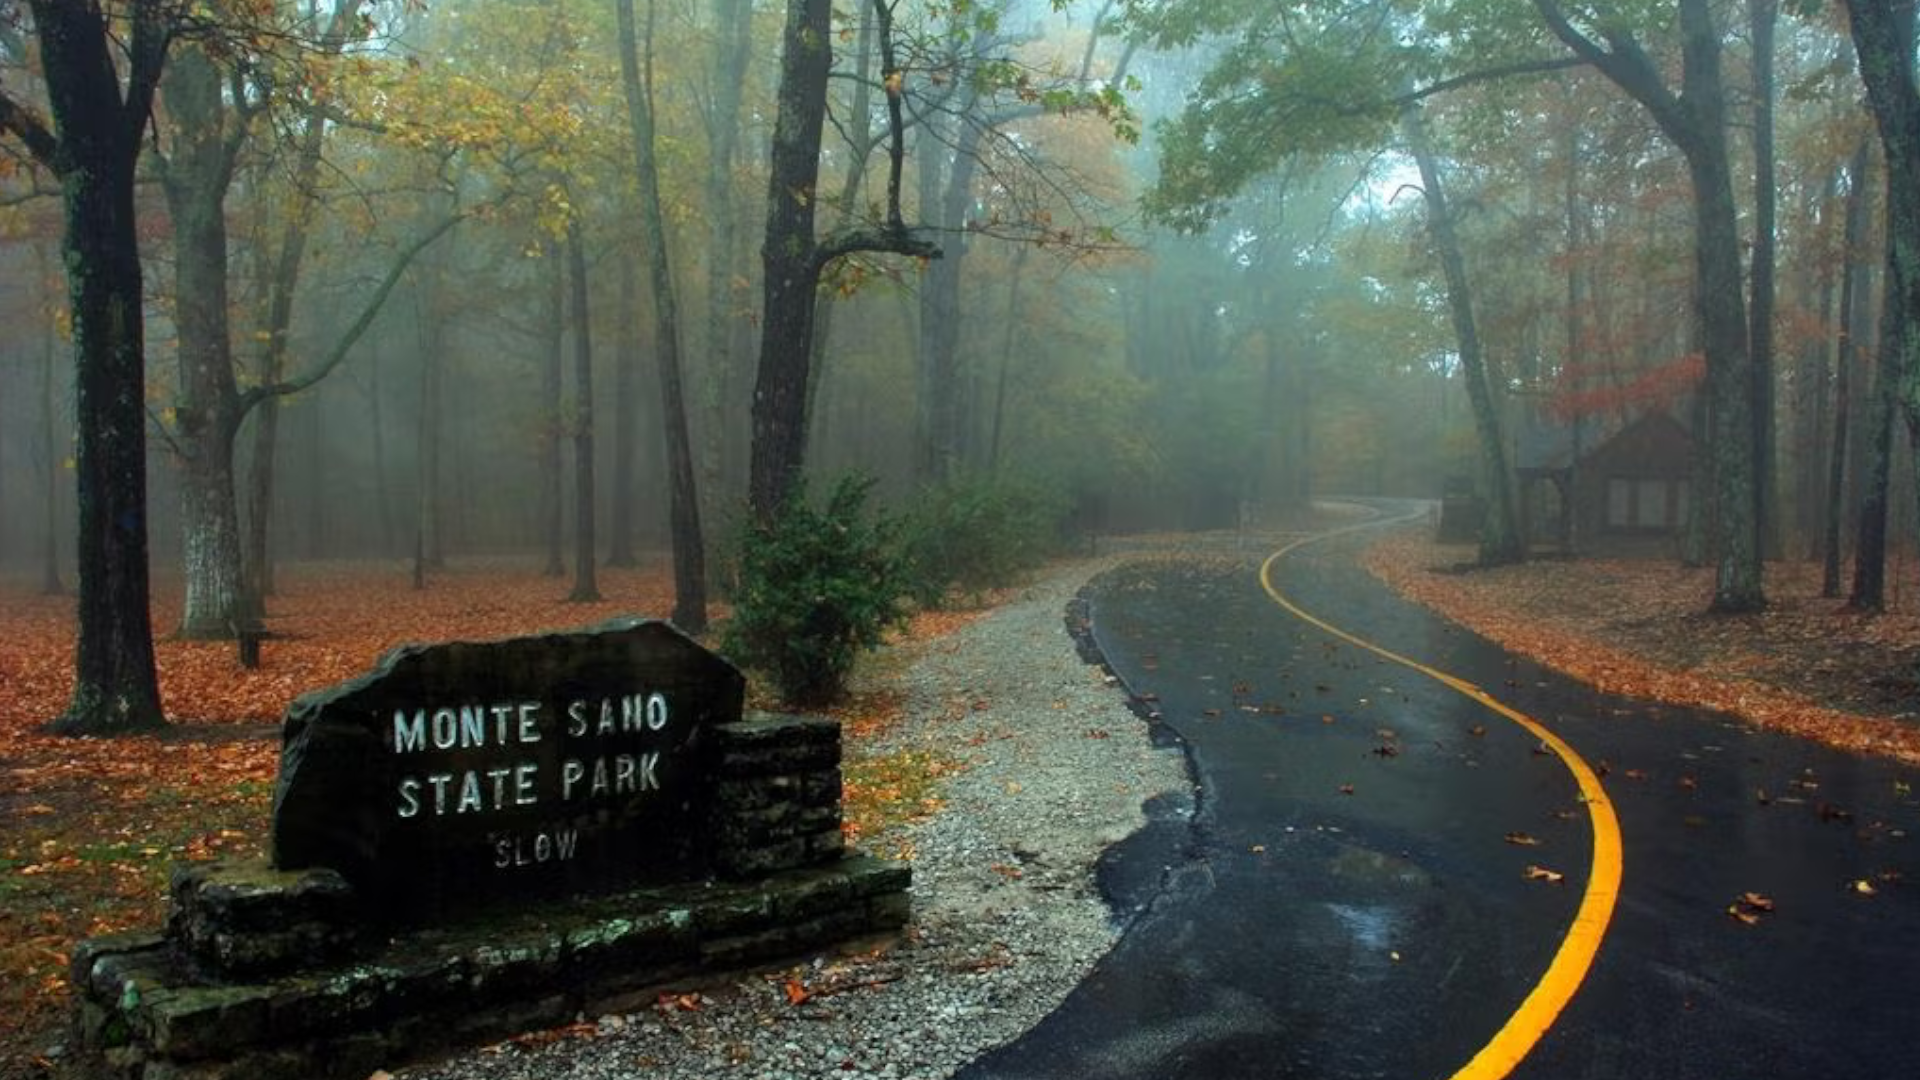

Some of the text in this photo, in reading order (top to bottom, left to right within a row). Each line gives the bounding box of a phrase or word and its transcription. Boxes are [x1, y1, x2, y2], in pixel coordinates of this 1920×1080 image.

[394, 693, 668, 753] MONTE SANO
[399, 752, 660, 817] STATE PARK
[494, 829, 578, 868] SLOW
